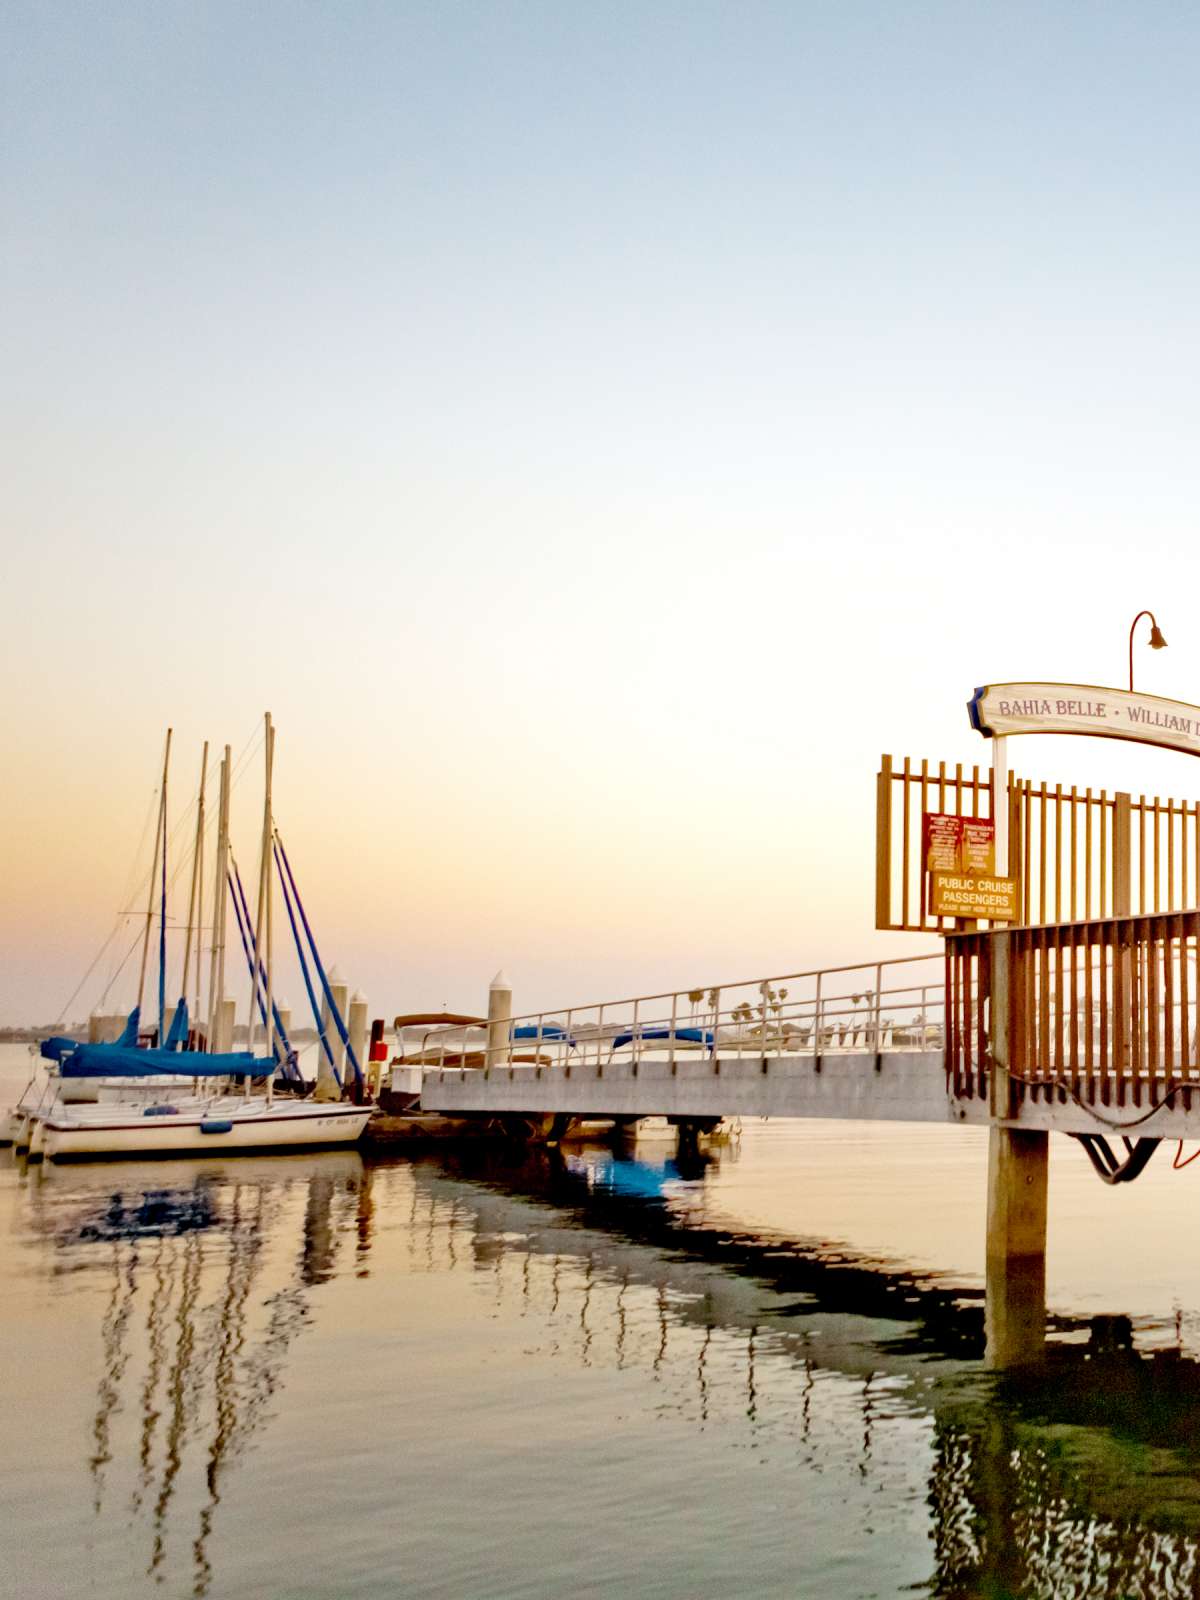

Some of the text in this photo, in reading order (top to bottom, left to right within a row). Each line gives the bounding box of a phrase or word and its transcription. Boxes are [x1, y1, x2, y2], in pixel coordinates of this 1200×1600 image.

[999, 700, 1052, 717] BAHIA
[1055, 700, 1107, 717] BELLE
[1127, 706, 1191, 735] WILLIAM
[938, 877, 1014, 894] PUBLIC CRUISE
[943, 891, 1009, 907] PASSENGERS
